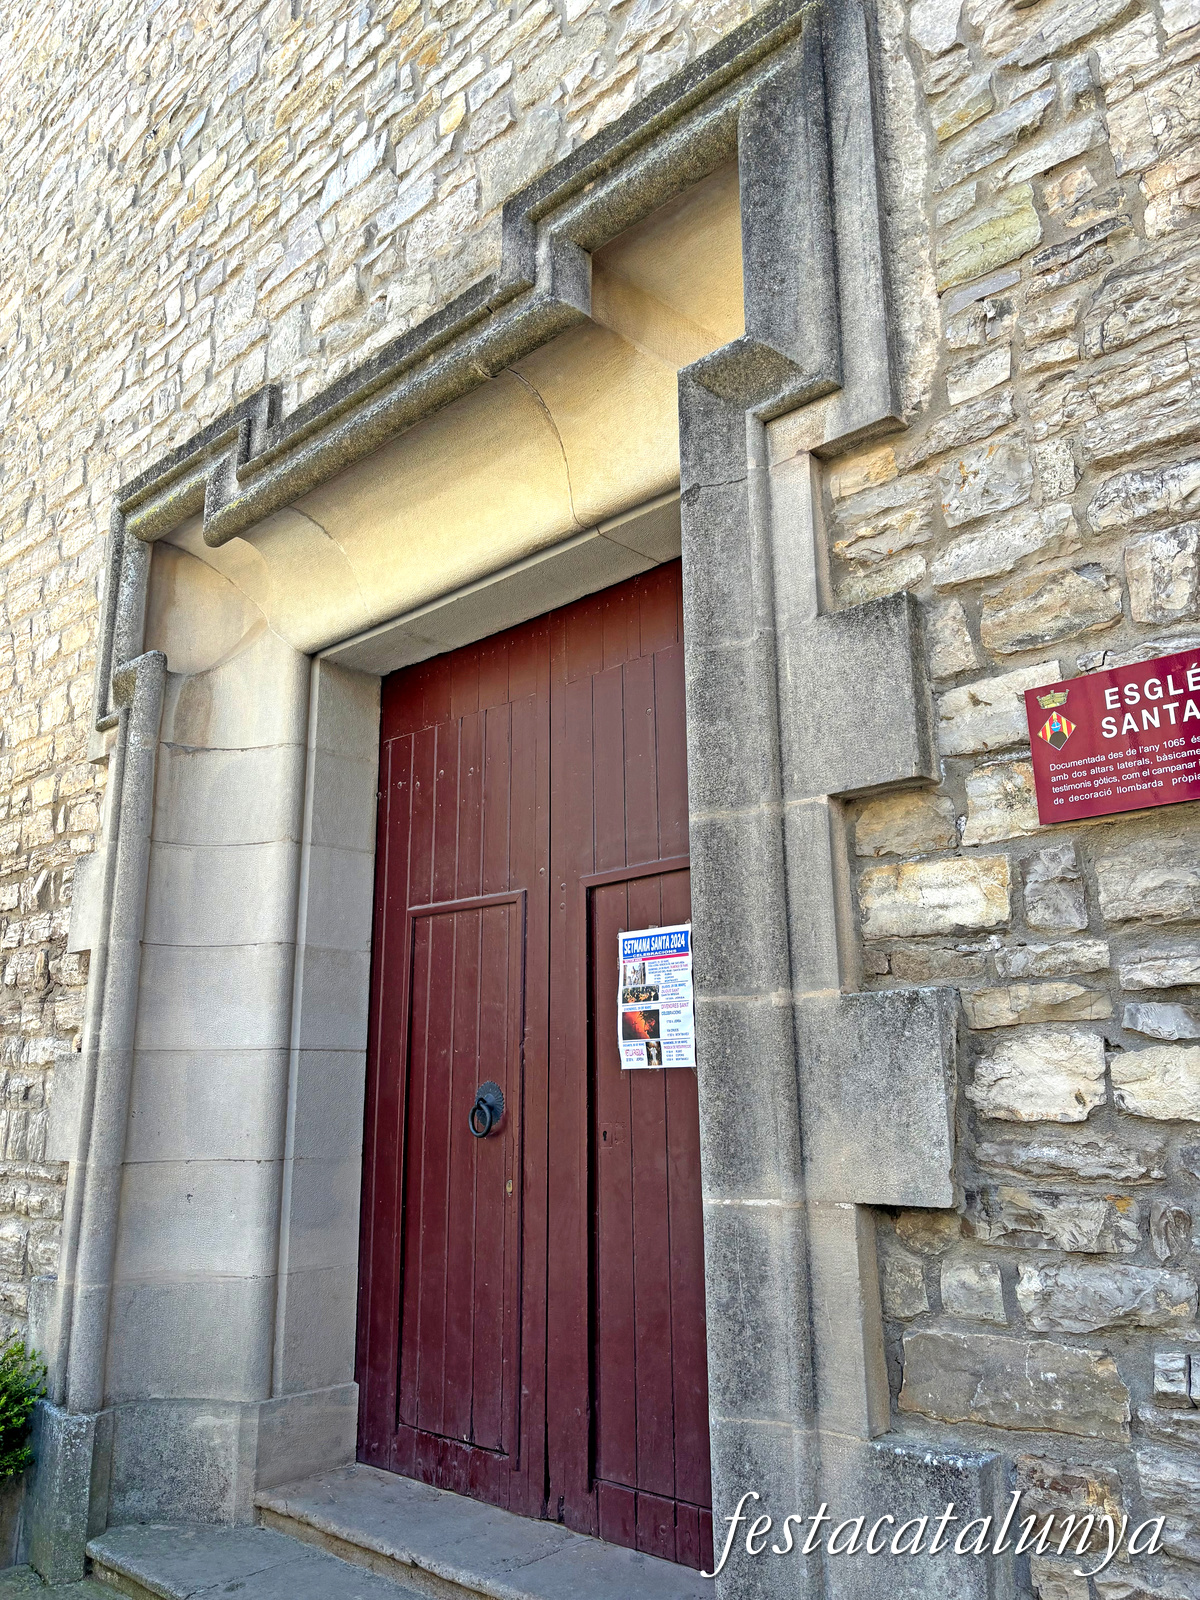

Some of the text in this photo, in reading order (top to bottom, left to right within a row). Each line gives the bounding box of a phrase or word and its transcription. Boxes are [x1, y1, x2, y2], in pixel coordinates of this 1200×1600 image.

[1104, 662, 1200, 710] ESGLÉ
[1101, 699, 1200, 738] SANTA
[1049, 752, 1106, 772] Documentada
[1108, 750, 1124, 760] des
[1126, 747, 1137, 757] de
[1139, 743, 1160, 757] l'any
[1163, 737, 1186, 749] 1065
[1051, 771, 1069, 783] amb
[1072, 770, 1087, 779] dos
[1090, 764, 1114, 776] altars
[1052, 780, 1092, 794] testimonis
[1122, 771, 1141, 781] com
[1142, 768, 1150, 777] el
[1152, 761, 1197, 776] campanar
[1053, 796, 1064, 806] de
[1068, 788, 1112, 803] decoració
[1116, 780, 1164, 794] llombarda
[624, 933, 686, 955] SETMANA SANTA 2024
